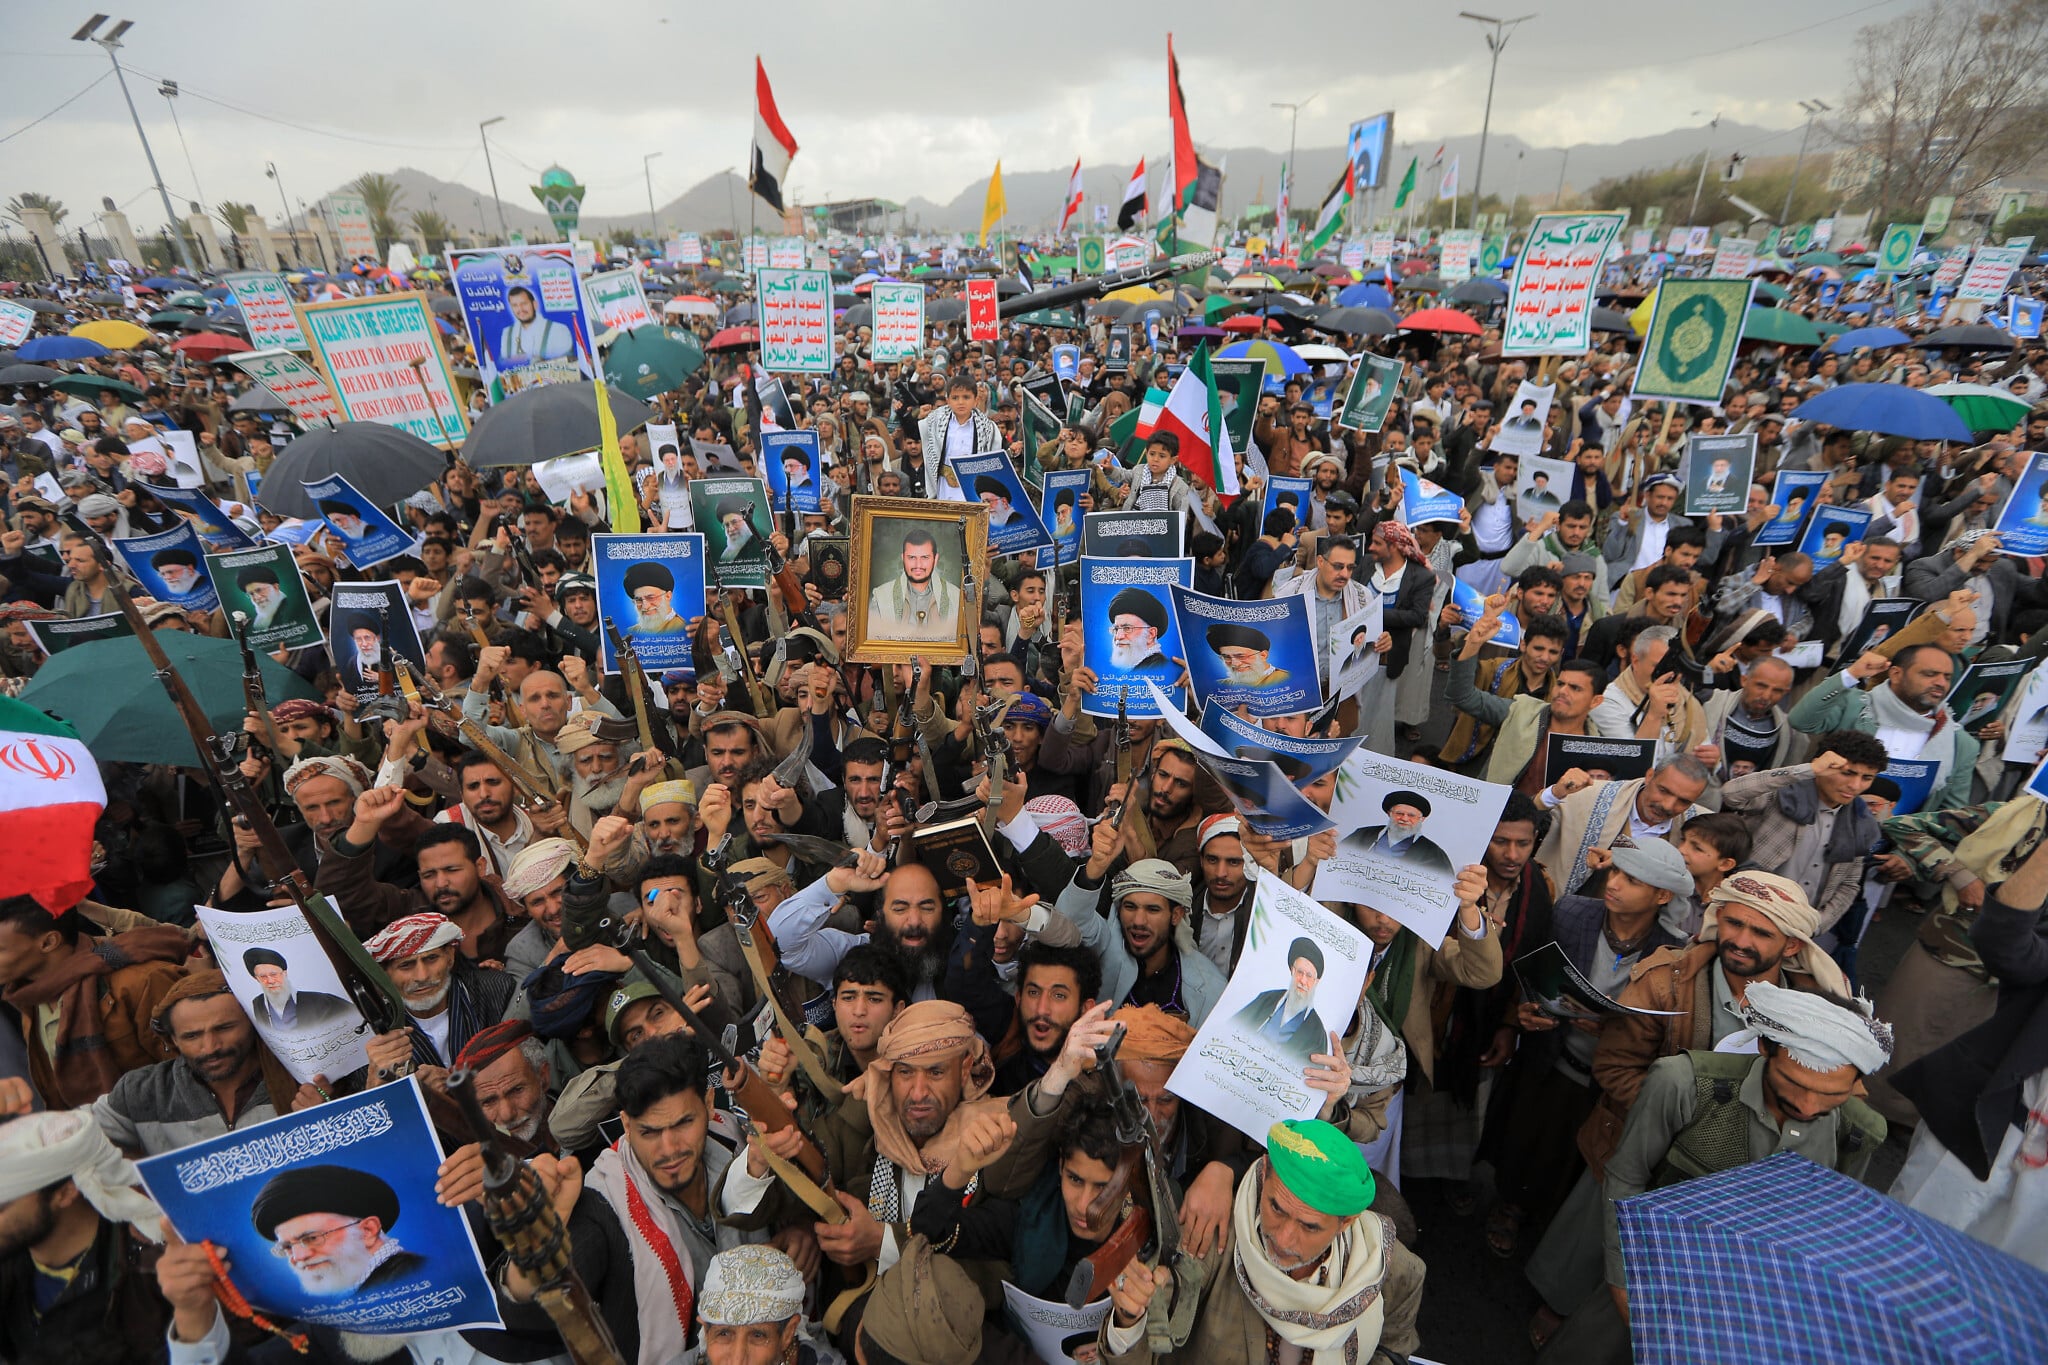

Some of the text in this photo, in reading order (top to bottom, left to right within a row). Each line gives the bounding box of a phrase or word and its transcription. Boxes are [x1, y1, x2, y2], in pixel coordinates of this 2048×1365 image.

[1534, 221, 1615, 249] الله أكبر
[764, 272, 825, 295] الله أكبر
[878, 290, 920, 306] الله أكبر
[316, 306, 424, 343] ALLAH IS THE GREATEST
[330, 341, 433, 370] DEATH TO AMERICA
[767, 347, 826, 365] النصر للإسلام
[341, 372, 379, 395] DEATH
[378, 371, 395, 389] TO
[351, 397, 382, 420] CURSE
[381, 395, 408, 417] UPON
[406, 391, 425, 412] THE
[409, 418, 428, 438] TO
[426, 414, 461, 437] ISAM
